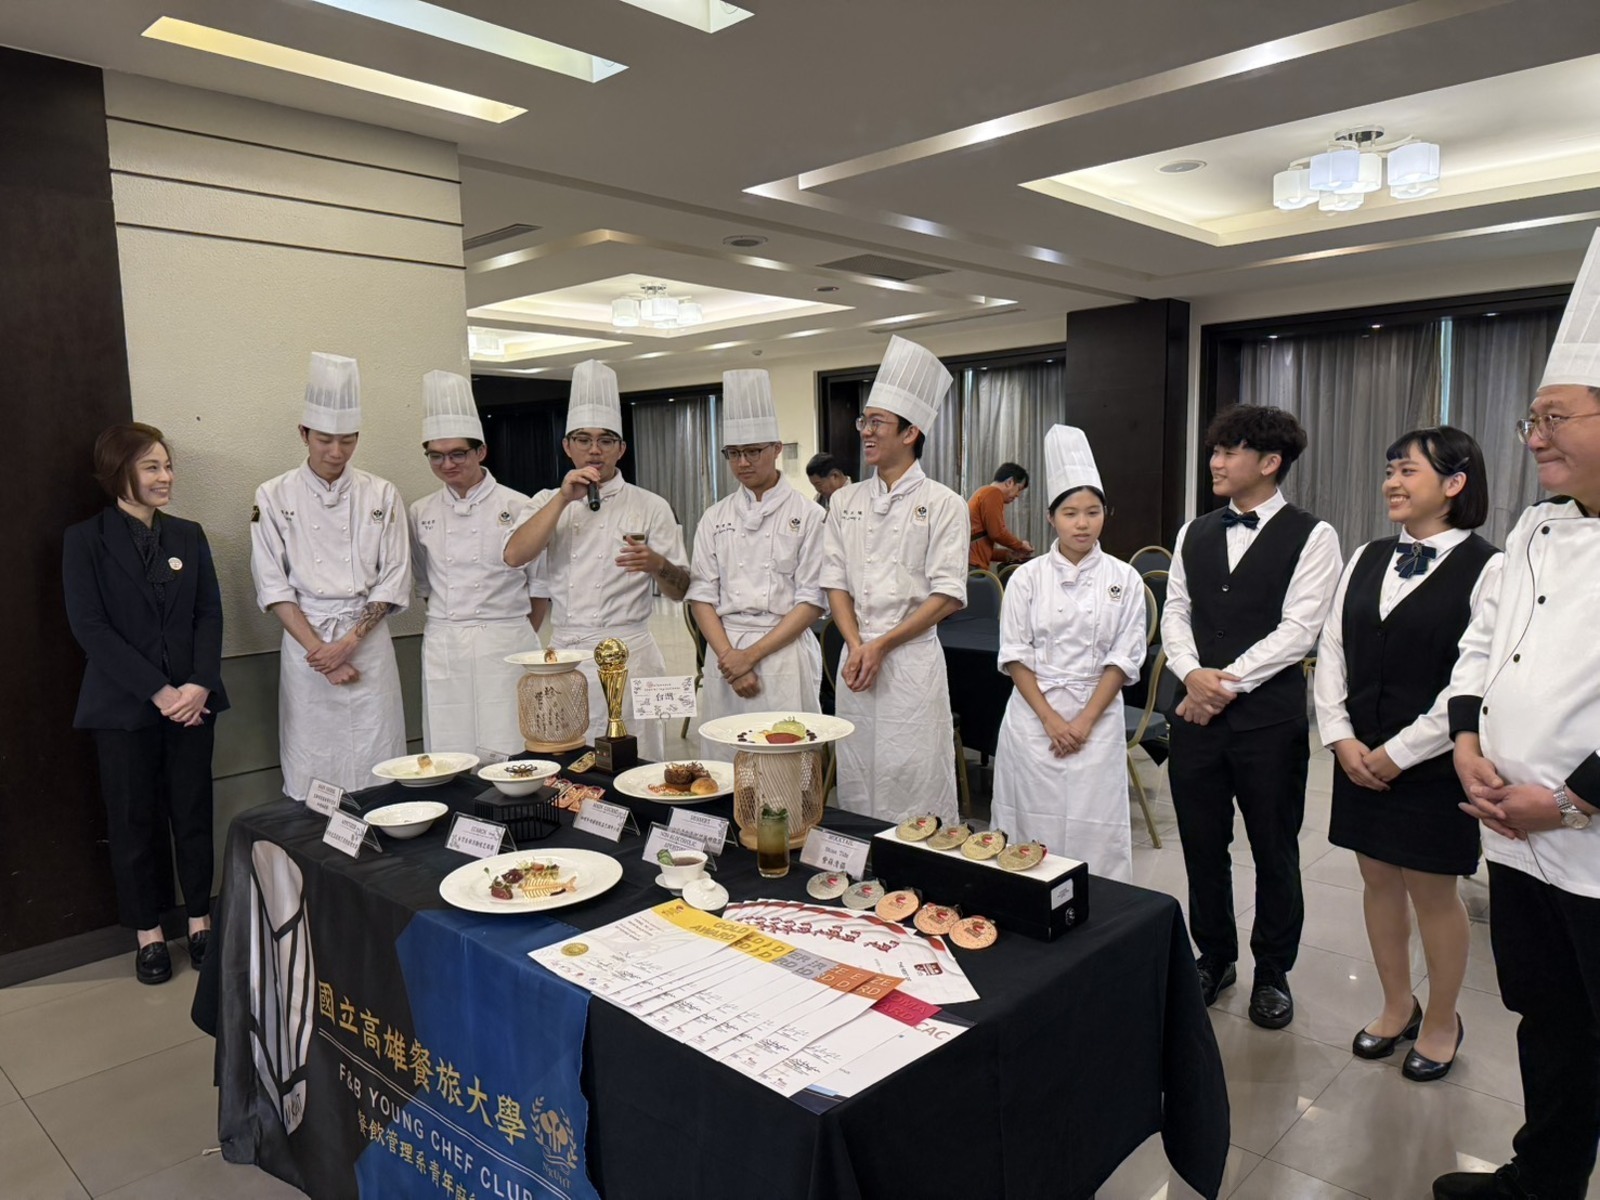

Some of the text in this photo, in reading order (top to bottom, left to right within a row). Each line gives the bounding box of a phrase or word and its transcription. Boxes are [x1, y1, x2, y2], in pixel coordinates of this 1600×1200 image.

[689, 924, 737, 941] AWARD
[713, 921, 749, 935] GOLD
[318, 979, 528, 1146] 國立高雄餐旅大學
[339, 1062, 362, 1099] F&B
[369, 1086, 424, 1140] YOUNG
[430, 1129, 474, 1175] CHEF
